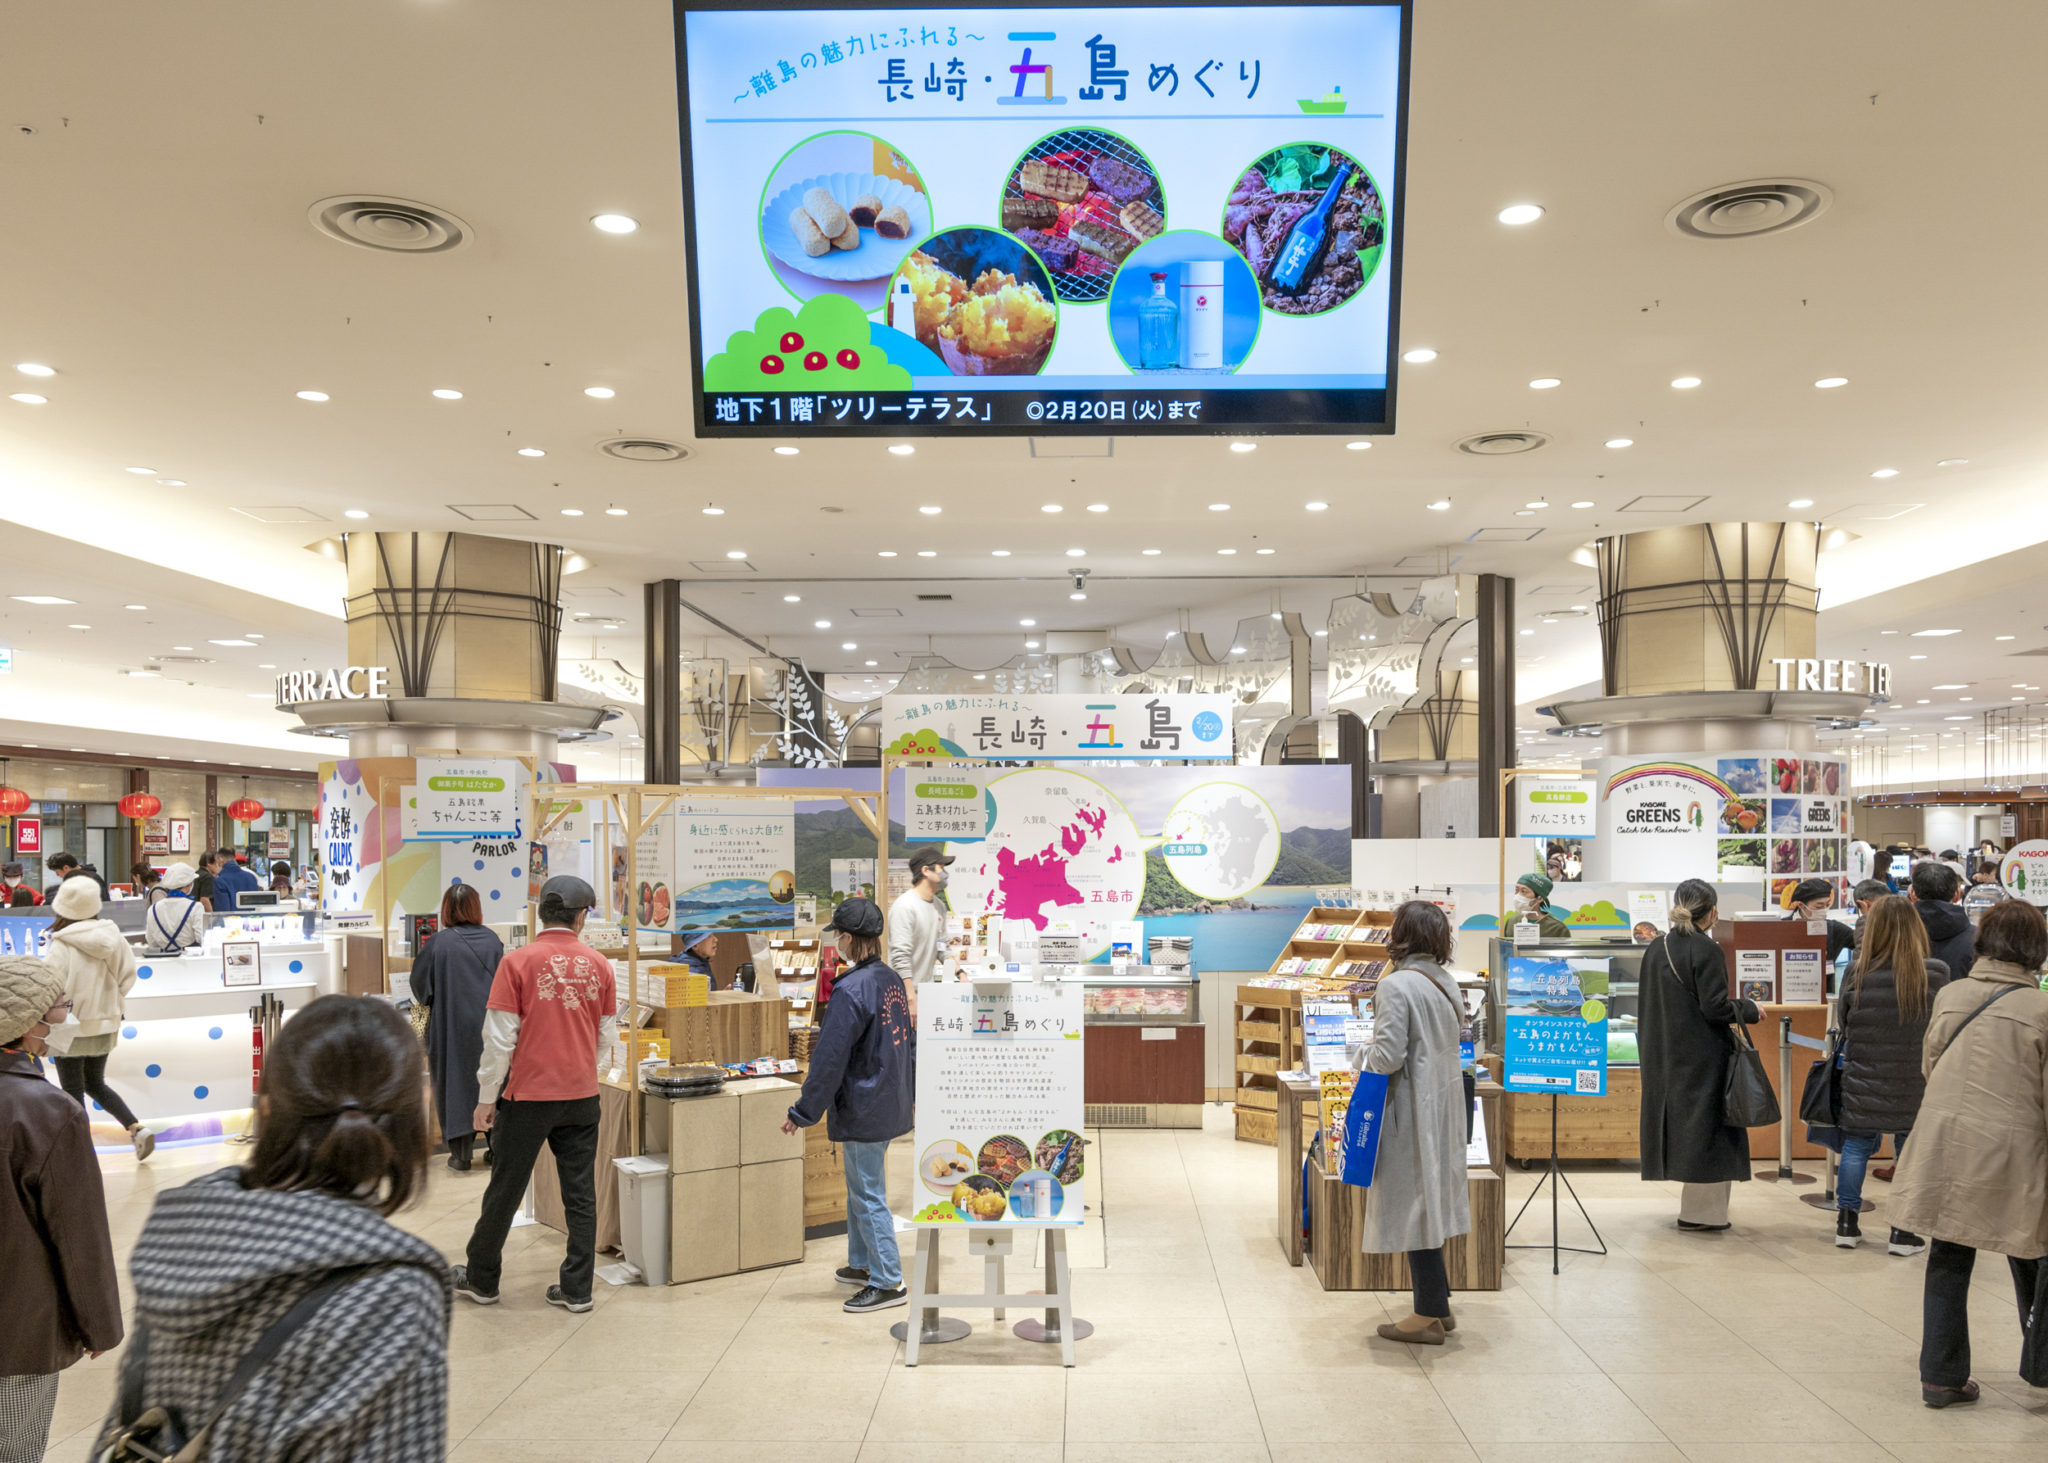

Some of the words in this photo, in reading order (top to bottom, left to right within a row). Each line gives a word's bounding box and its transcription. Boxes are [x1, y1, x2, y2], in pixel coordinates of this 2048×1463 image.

[877, 31, 1261, 105] 長崎・五島めぐり
[1772, 658, 1855, 692] TREE
[276, 666, 388, 704] TERRACE
[972, 698, 1182, 750] 長崎・五島
[431, 809, 503, 823] ちゃんここ等
[1529, 813, 1587, 825] かんころもち
[1626, 808, 1681, 823] GREENS
[1807, 807, 1831, 822] GREENS
[689, 823, 785, 837] 身近に感じられる大自然
[1616, 825, 1639, 834] Catch
[1640, 825, 1653, 834] the
[1654, 825, 1693, 834] Rainbow
[328, 842, 353, 867] CALPIS
[472, 840, 518, 858] PARLOR
[1090, 889, 1134, 903] 五島市
[1535, 973, 1581, 986] 五島列島
[932, 1009, 1066, 1034] 長崎・五島めぐり
